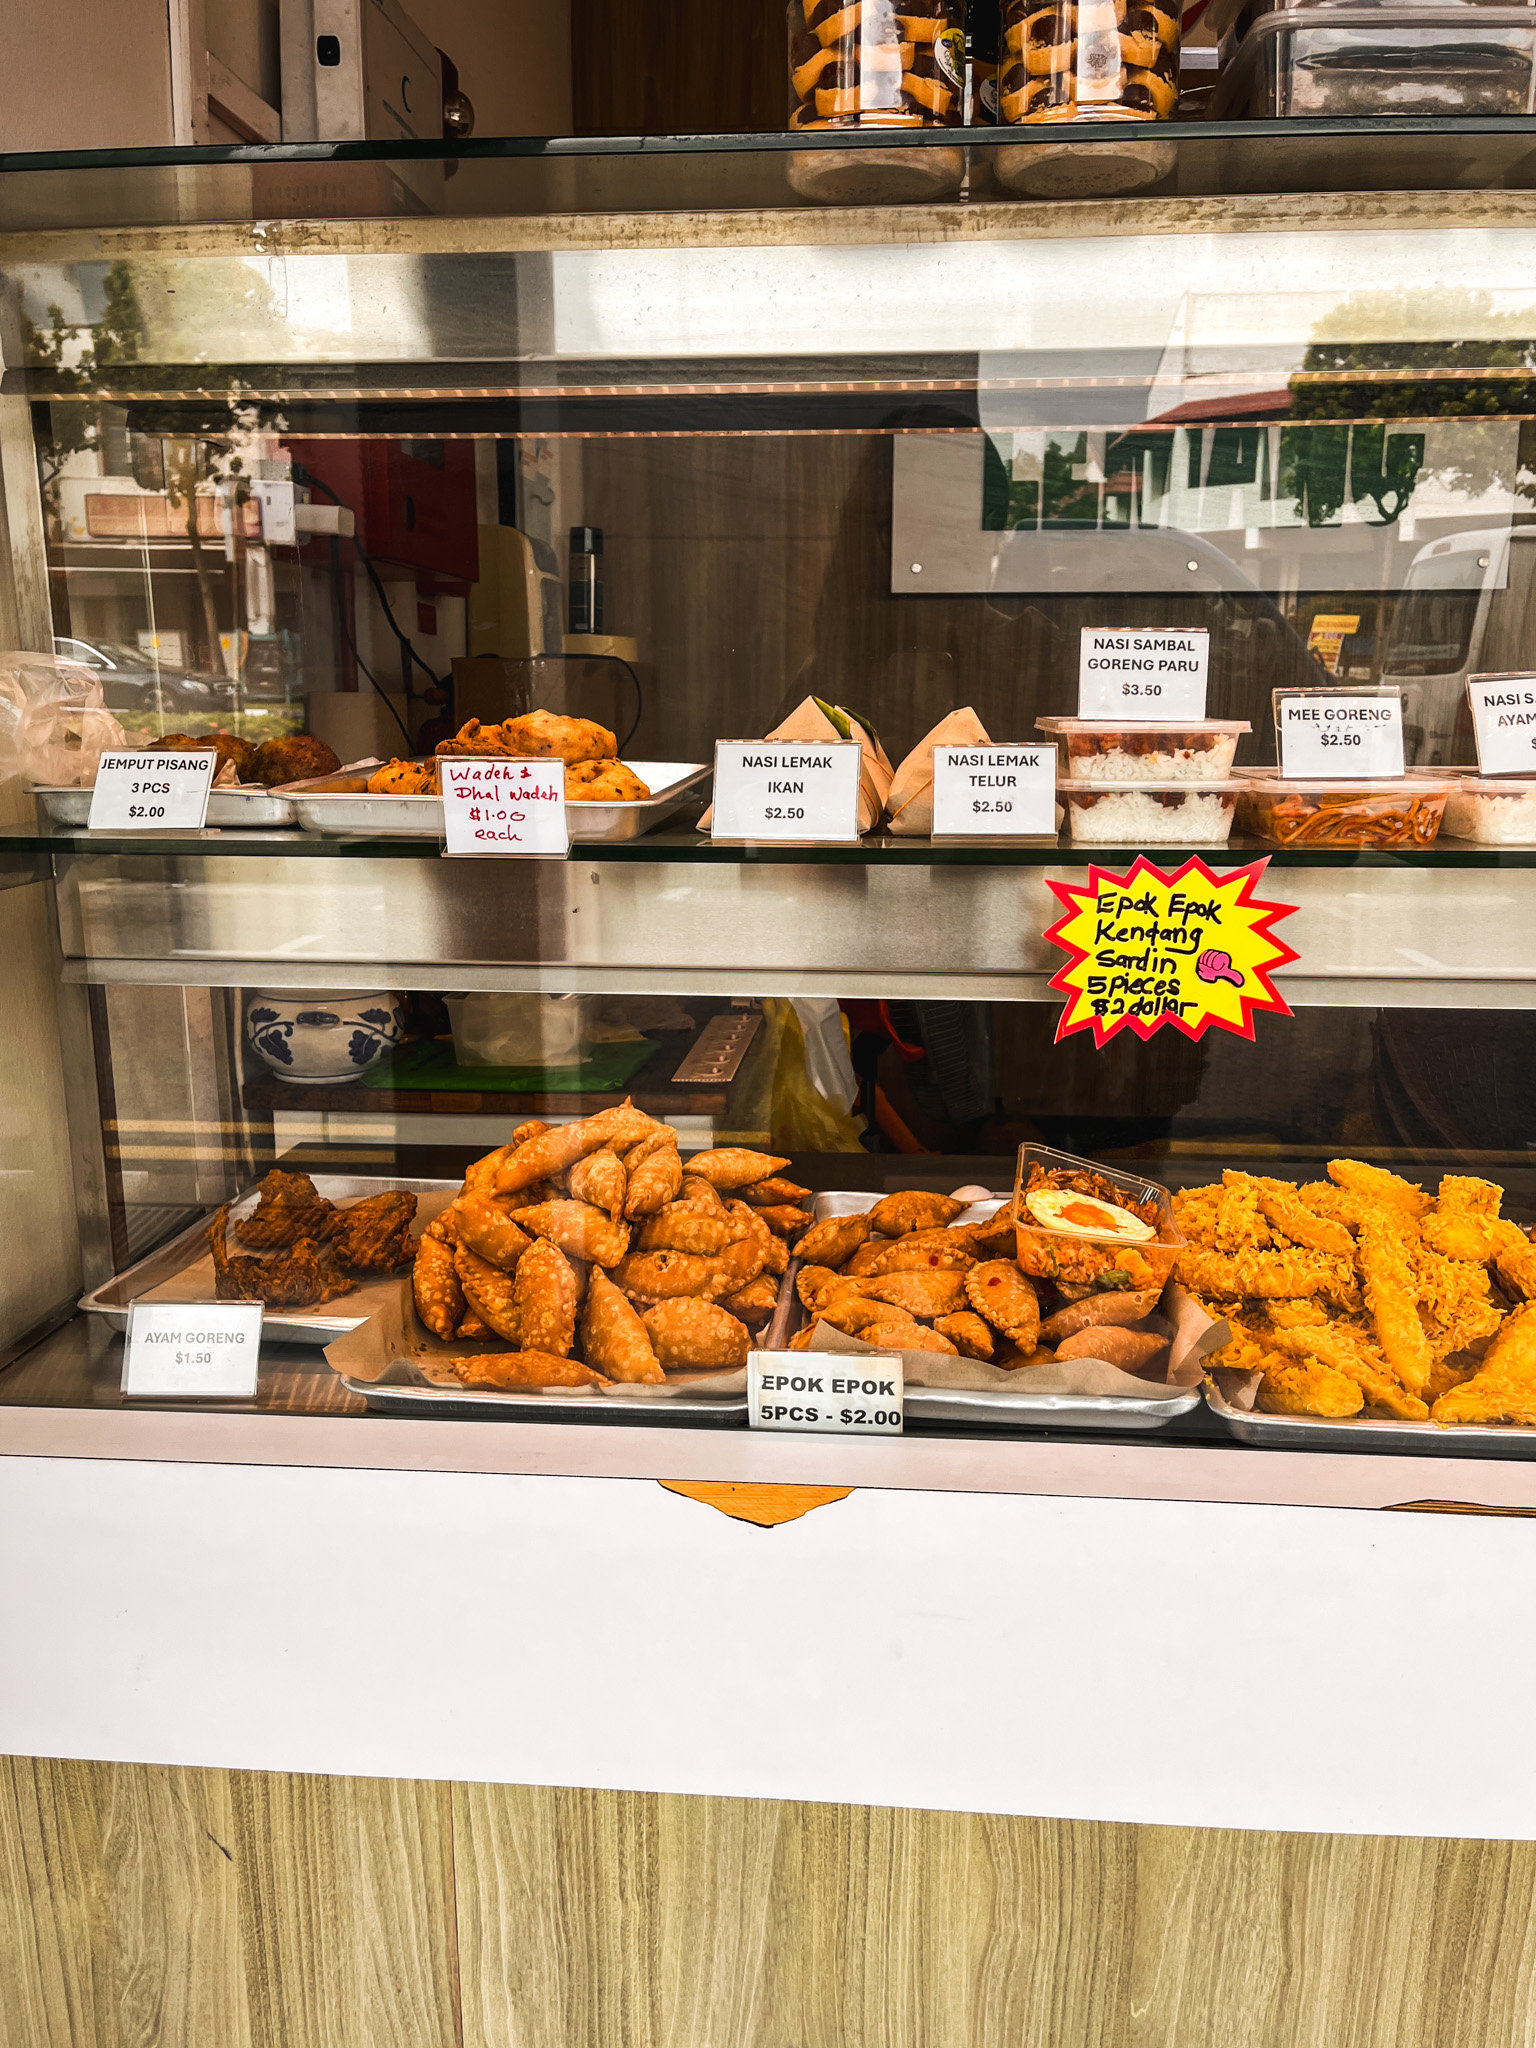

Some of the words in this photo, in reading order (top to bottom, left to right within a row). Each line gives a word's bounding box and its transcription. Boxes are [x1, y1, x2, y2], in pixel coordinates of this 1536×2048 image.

[1094, 638, 1129, 650] NASI
[1134, 639, 1195, 651] SAMBAL
[1088, 658, 1154, 671] GORENG
[1159, 660, 1199, 672] PARU
[1122, 683, 1162, 696] $3.50
[1484, 693, 1521, 707] NASI
[1524, 693, 1536, 704] S
[1289, 709, 1320, 720] MEE
[1325, 709, 1392, 720] GORENG
[1321, 733, 1361, 747] $2.50
[101, 758, 155, 770] JEMPUT
[156, 759, 209, 771] PISANG
[742, 756, 778, 768] NASI
[782, 756, 833, 769] LEMAK
[948, 755, 984, 766] NASI
[987, 755, 1040, 767] LEMAK
[450, 764, 514, 781] Wadeh
[131, 782, 140, 793] 3
[142, 783, 170, 794] PCS
[768, 781, 804, 794] IKAN
[969, 775, 1017, 787] TELUR
[454, 785, 500, 802] Dhal
[129, 805, 165, 818] $2.00
[764, 806, 805, 820] $2.50
[972, 800, 1013, 814] $2.50
[469, 807, 526, 822] $1.00
[475, 825, 523, 841] each
[1096, 891, 1159, 919] Epok
[1168, 893, 1222, 925] Epok
[1096, 947, 1178, 975] Sardin
[144, 1332, 181, 1344] AYAM
[185, 1332, 246, 1344] GORENG
[175, 1352, 212, 1365] $1.50
[762, 1375, 824, 1393] EPOK
[832, 1378, 896, 1396] EPOK
[760, 1405, 819, 1422] 5PCS
[839, 1408, 901, 1426] $2.00
